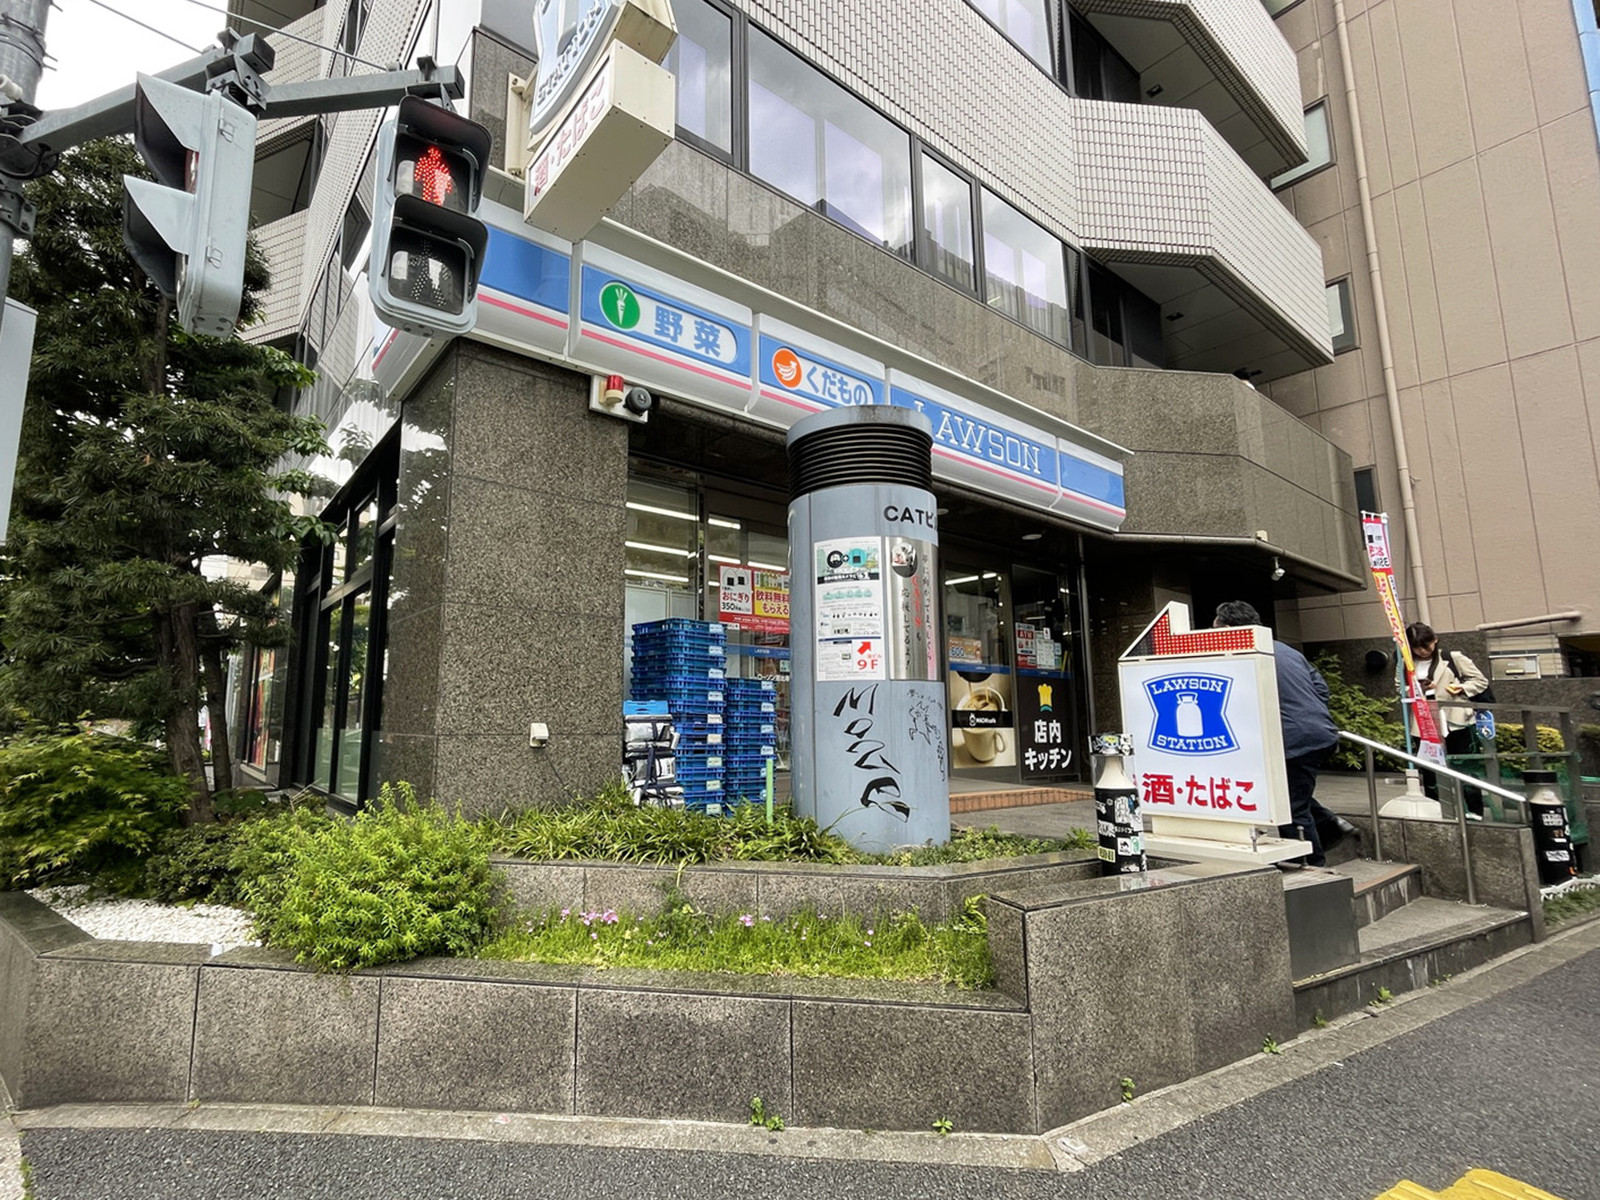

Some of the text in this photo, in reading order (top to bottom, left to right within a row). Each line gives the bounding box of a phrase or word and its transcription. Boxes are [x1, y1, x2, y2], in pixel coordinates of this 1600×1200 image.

[654, 304, 721, 358] 野菜
[806, 365, 868, 405] くだもの
[914, 400, 1042, 475] AWSON
[1150, 678, 1224, 695] LAWSON
[1034, 719, 1062, 744] 店内
[1156, 734, 1229, 751] STATION
[1024, 747, 1072, 771] キッチン
[1142, 772, 1258, 812] 酒・たばこ
